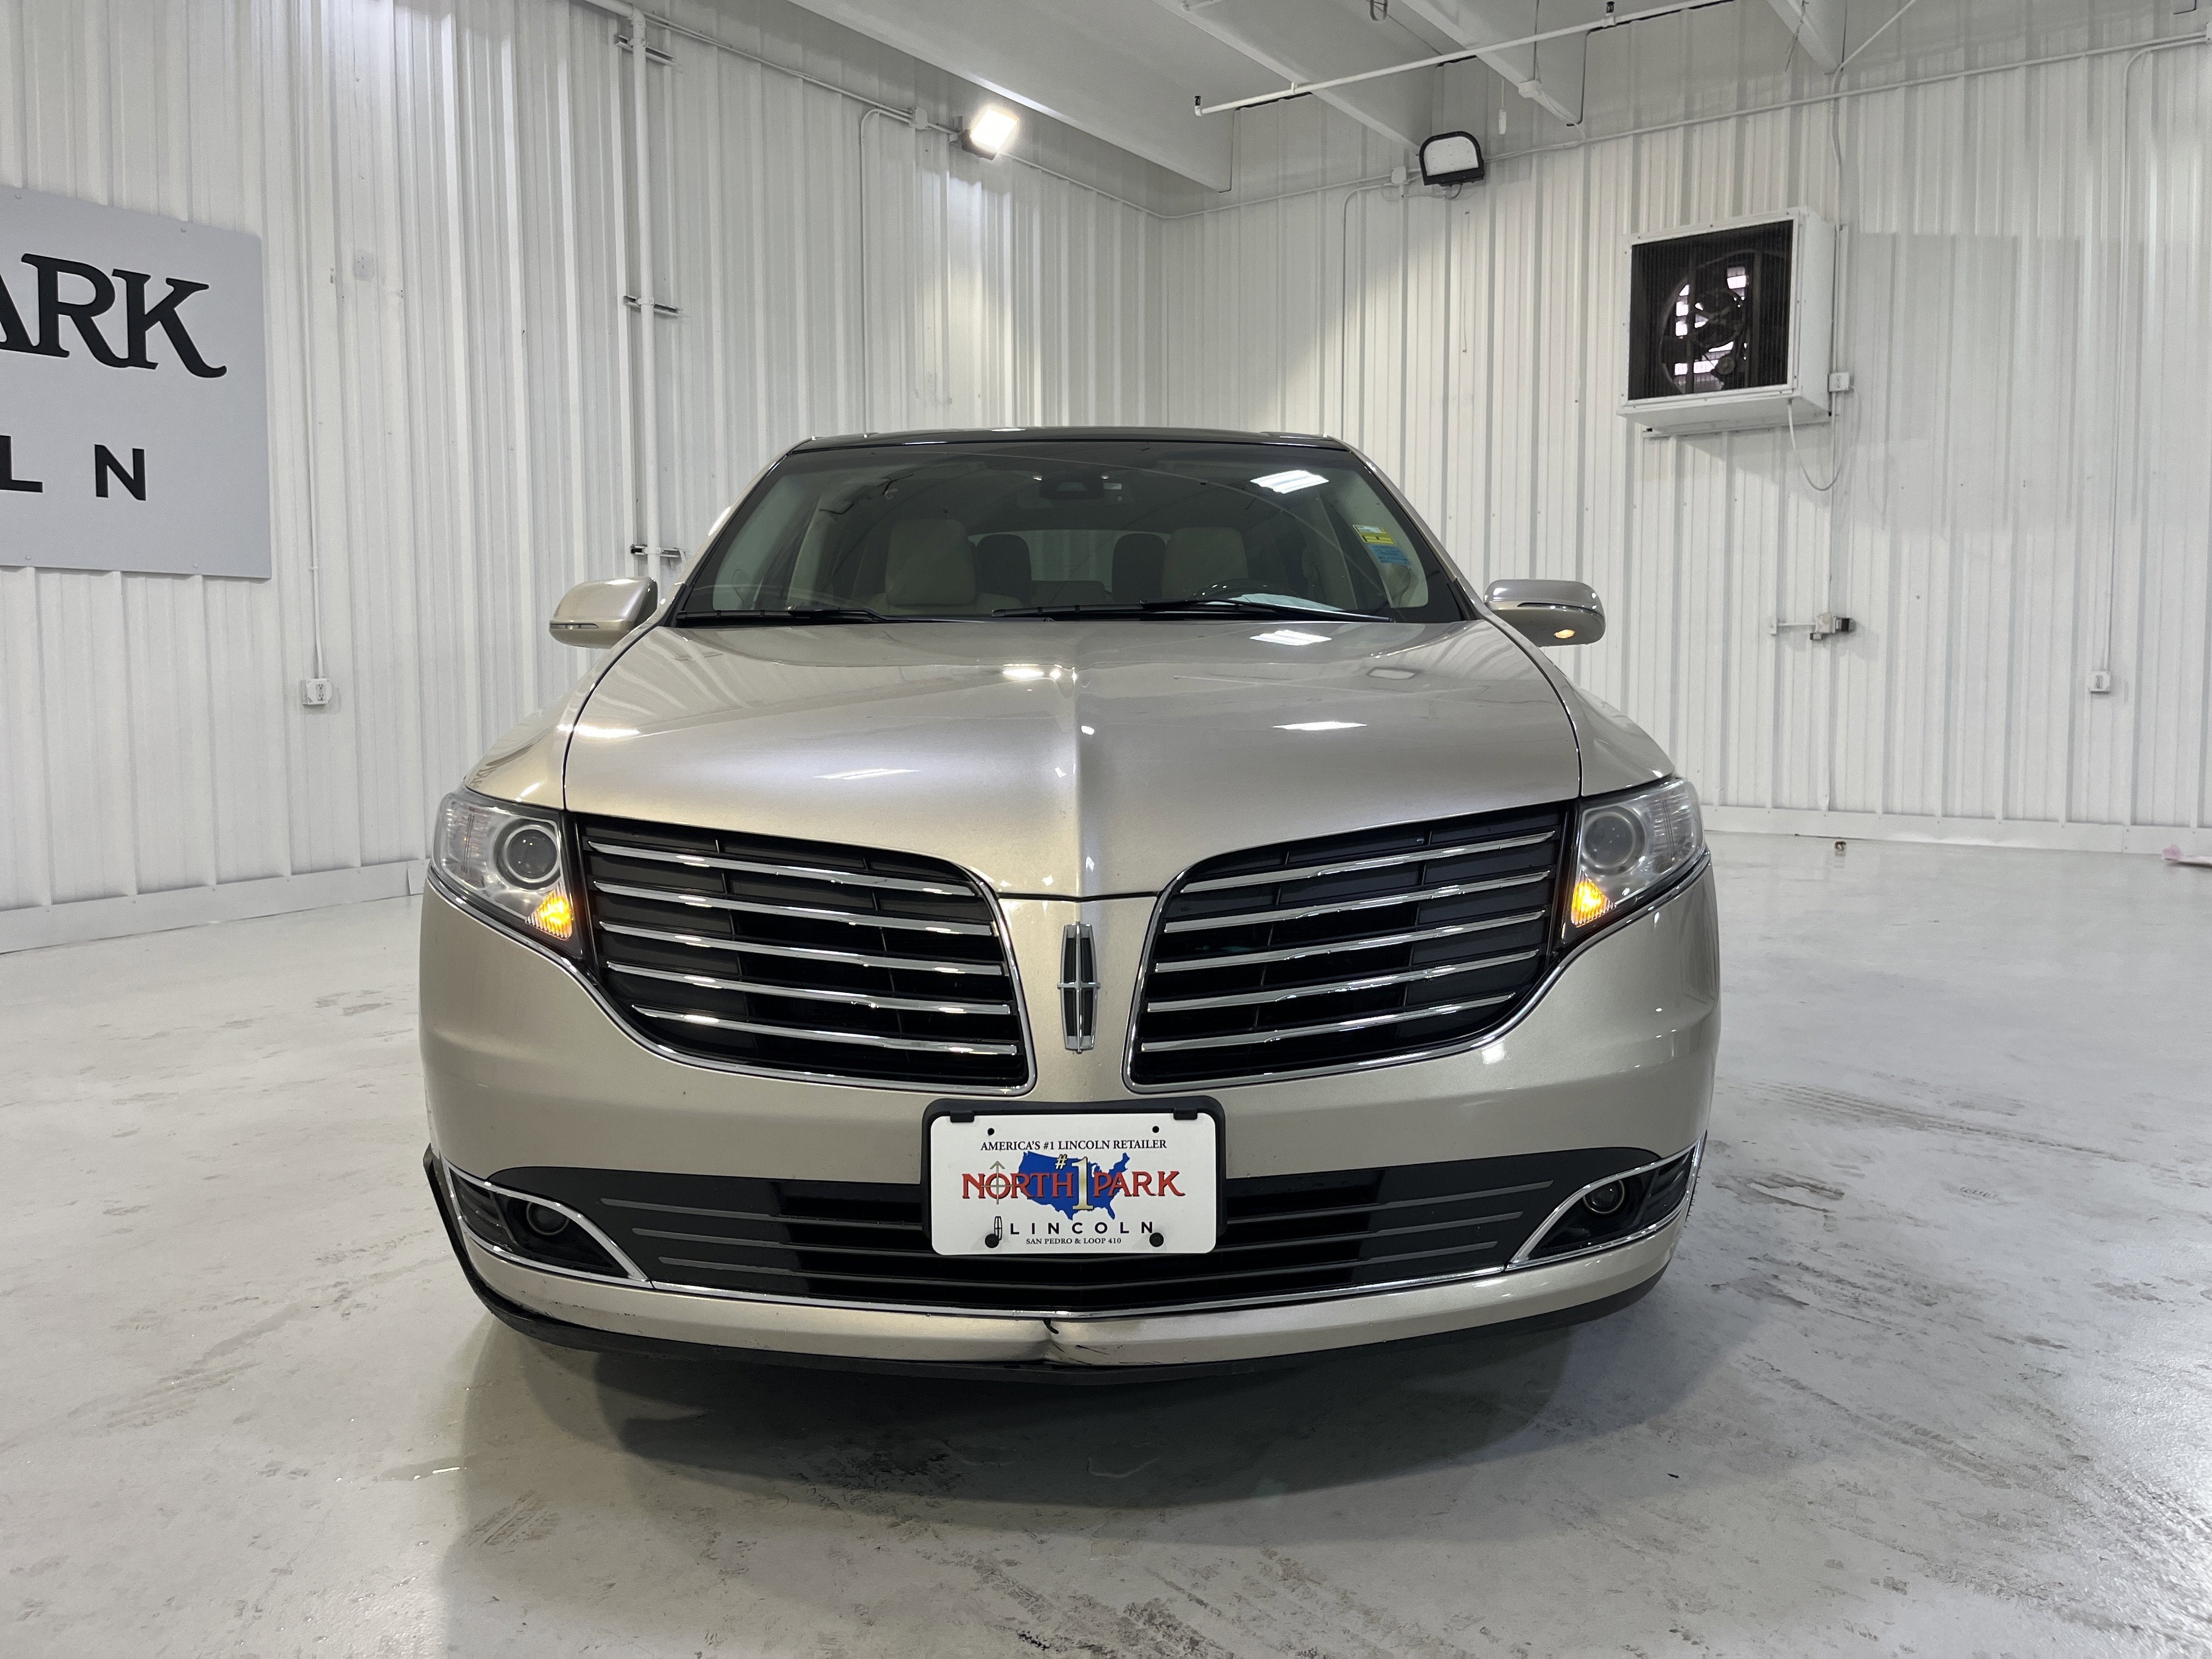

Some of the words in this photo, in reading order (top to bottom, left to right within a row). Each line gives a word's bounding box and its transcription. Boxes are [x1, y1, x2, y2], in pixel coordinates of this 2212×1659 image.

[980, 1141, 1041, 1151] AMERICA'S
[1043, 1141, 1054, 1150] #1
[1058, 1140, 1110, 1150] LINCOLN
[1113, 1139, 1167, 1149] RETAILER
[962, 1171, 1073, 1199] NORTH
[1093, 1170, 1186, 1197] PARK
[1010, 1221, 1153, 1235] LINCOLN
